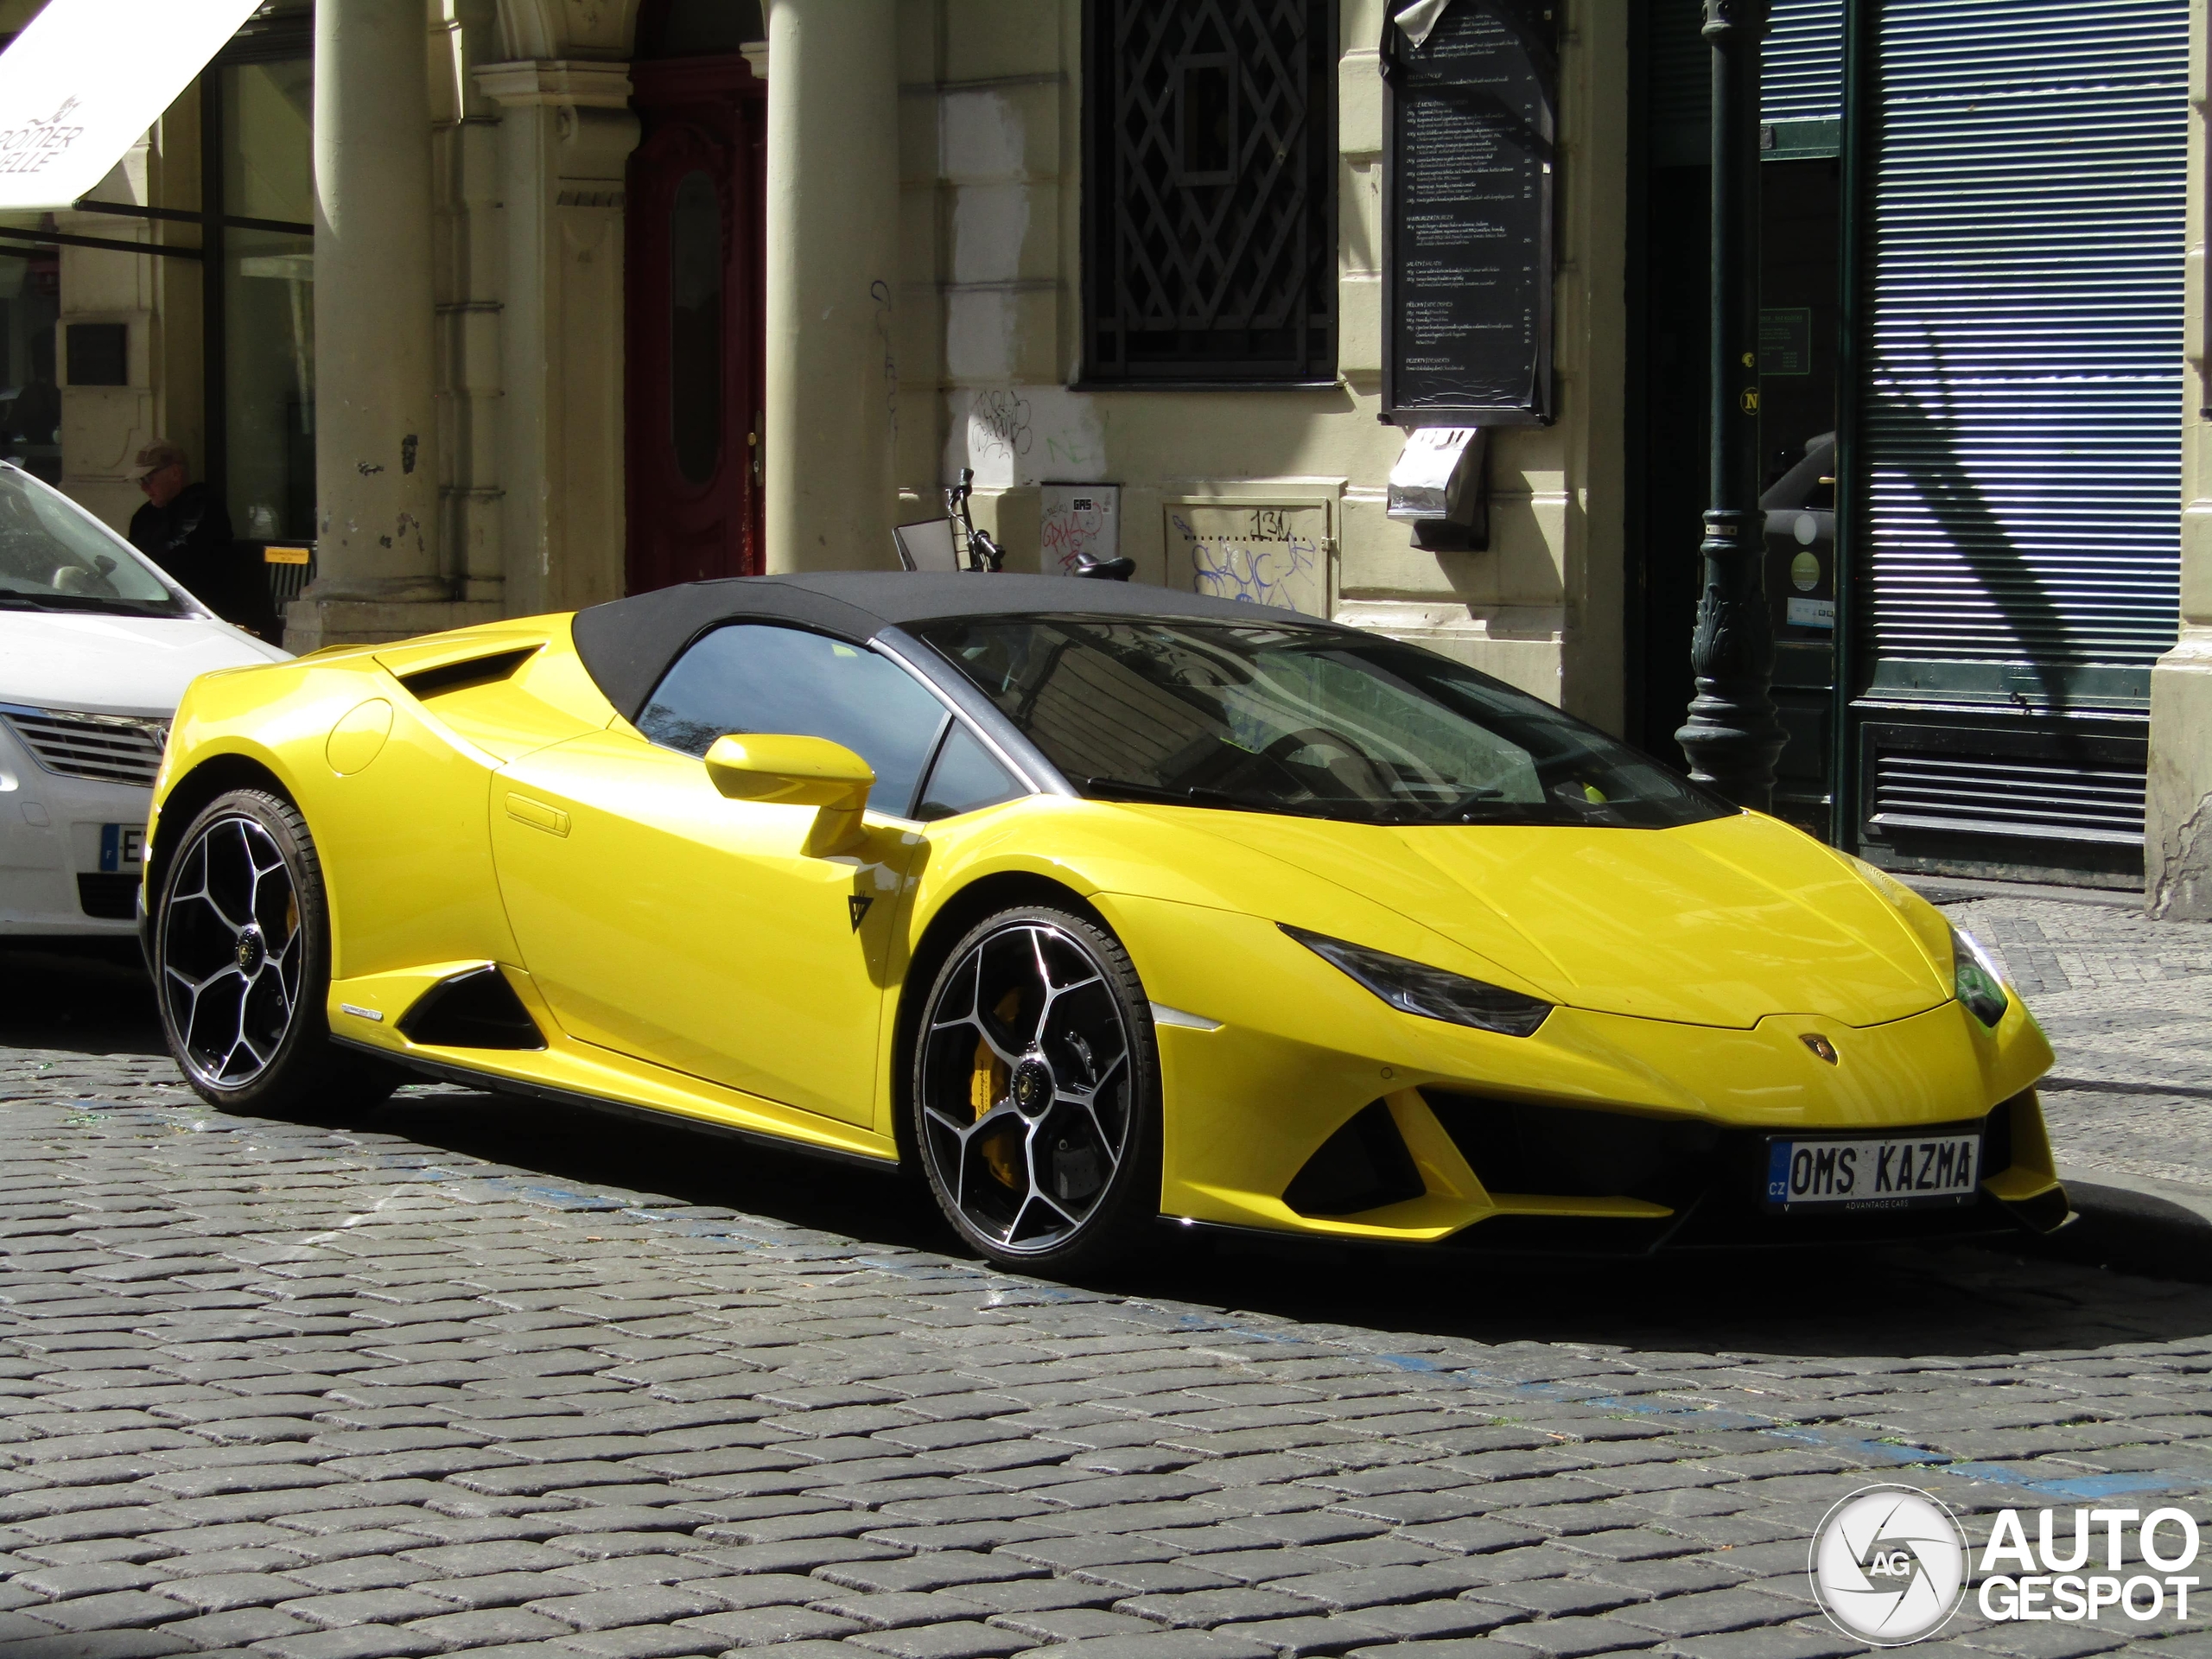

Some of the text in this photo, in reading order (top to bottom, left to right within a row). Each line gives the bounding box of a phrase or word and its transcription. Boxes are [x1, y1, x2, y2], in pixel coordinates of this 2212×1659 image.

[0, 151, 60, 174] ELLE
[1745, 393, 1758, 410] N
[1073, 499, 1092, 511] GAS
[1790, 1141, 1971, 1196] OMS KAZMA
[1769, 1181, 1785, 1196] CZ
[1845, 1199, 1890, 1210] ADVANTAGE
[1891, 1198, 1910, 1208] CARS
